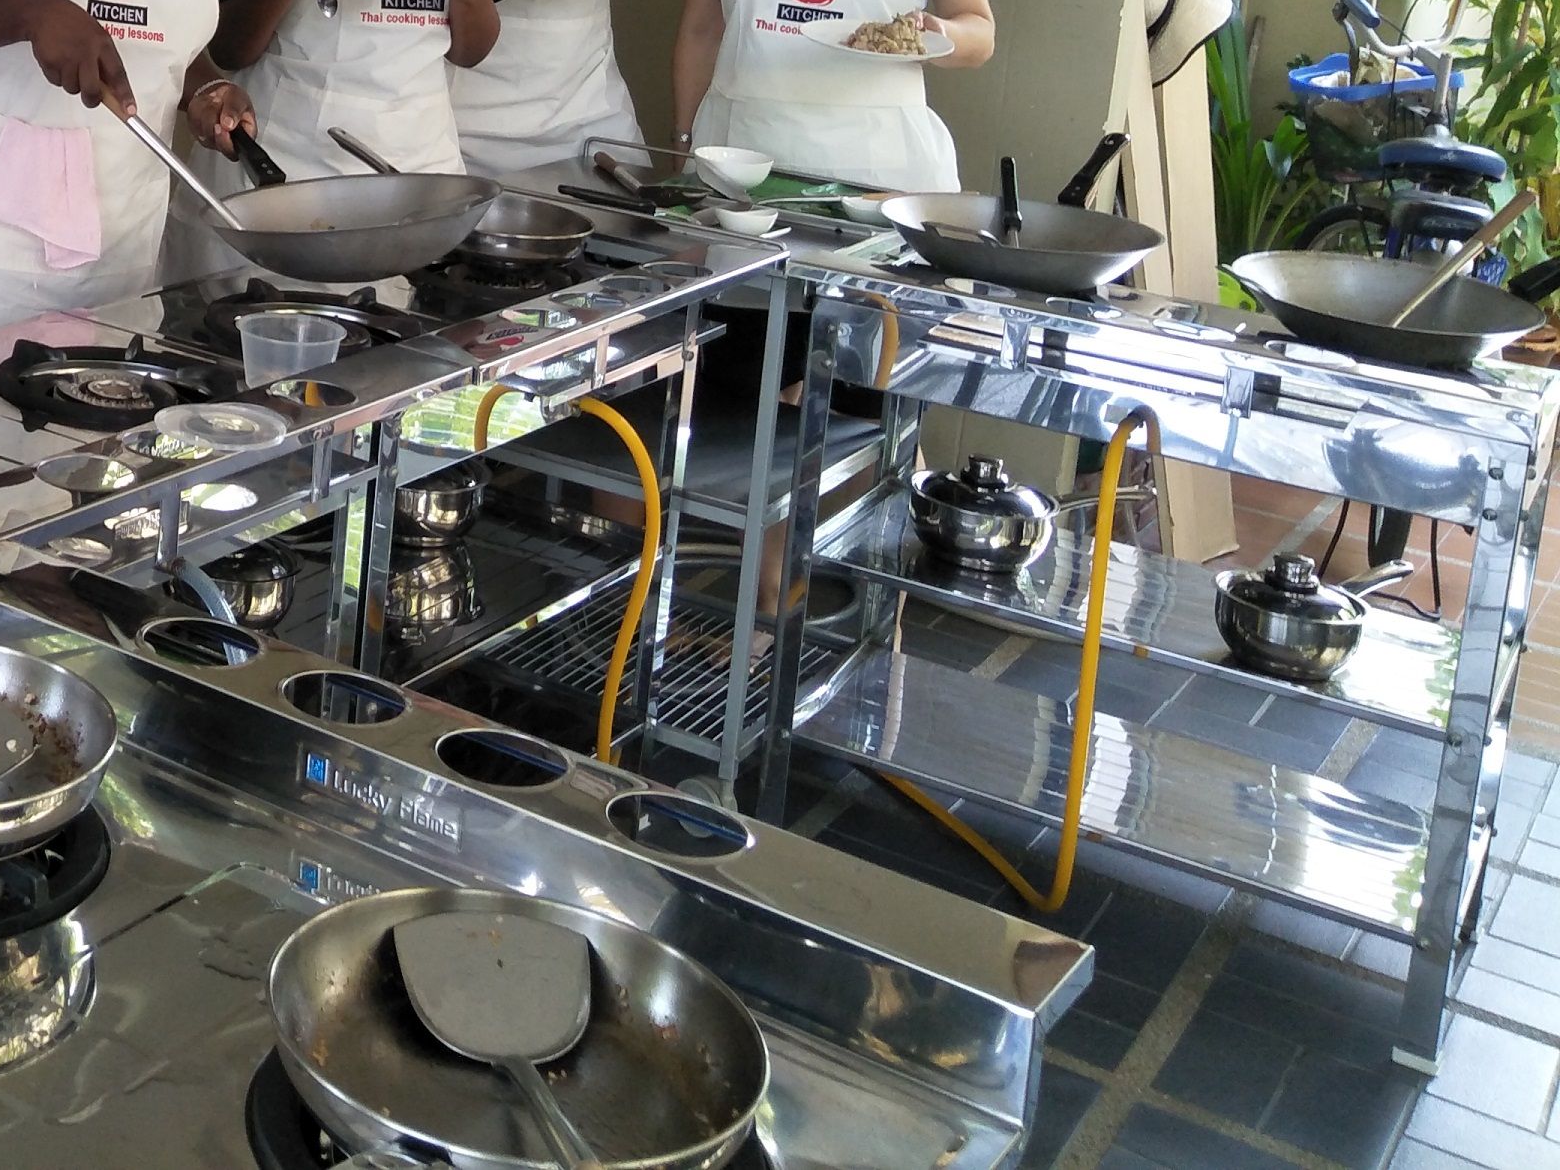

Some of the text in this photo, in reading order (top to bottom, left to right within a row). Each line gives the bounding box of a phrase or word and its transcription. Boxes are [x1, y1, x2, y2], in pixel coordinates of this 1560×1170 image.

[90, 3, 144, 23] KITCHEN
[361, 12, 383, 23] Thai
[386, 13, 425, 27] cooking
[104, 24, 164, 42] king lessons
[756, 19, 777, 31] Thai
[334, 770, 458, 840] Lucky Flame
